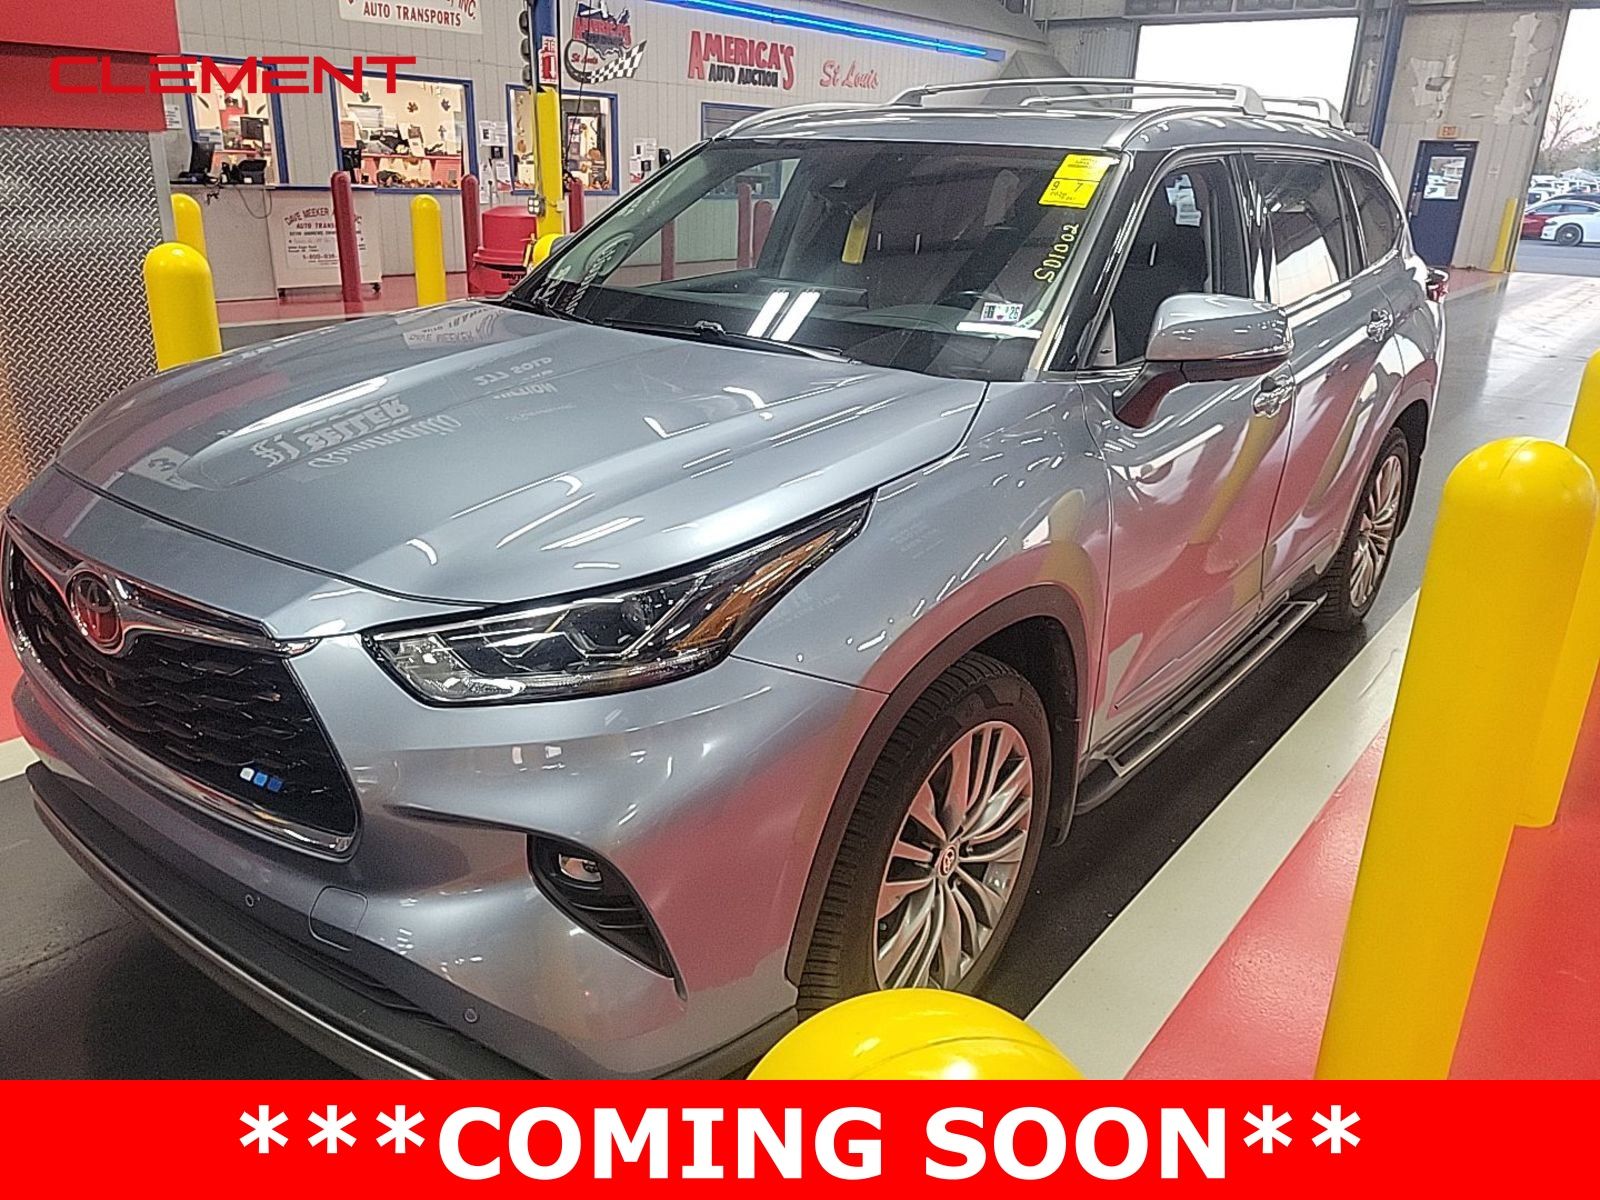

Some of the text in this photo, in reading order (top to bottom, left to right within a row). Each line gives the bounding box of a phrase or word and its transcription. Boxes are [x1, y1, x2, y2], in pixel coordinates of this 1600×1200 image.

[363, 1, 461, 27] AUTO TRANSPORTS
[687, 30, 796, 90] AMERICA'S
[708, 63, 779, 89] AUTO AUCTION
[819, 59, 880, 90] St Louis
